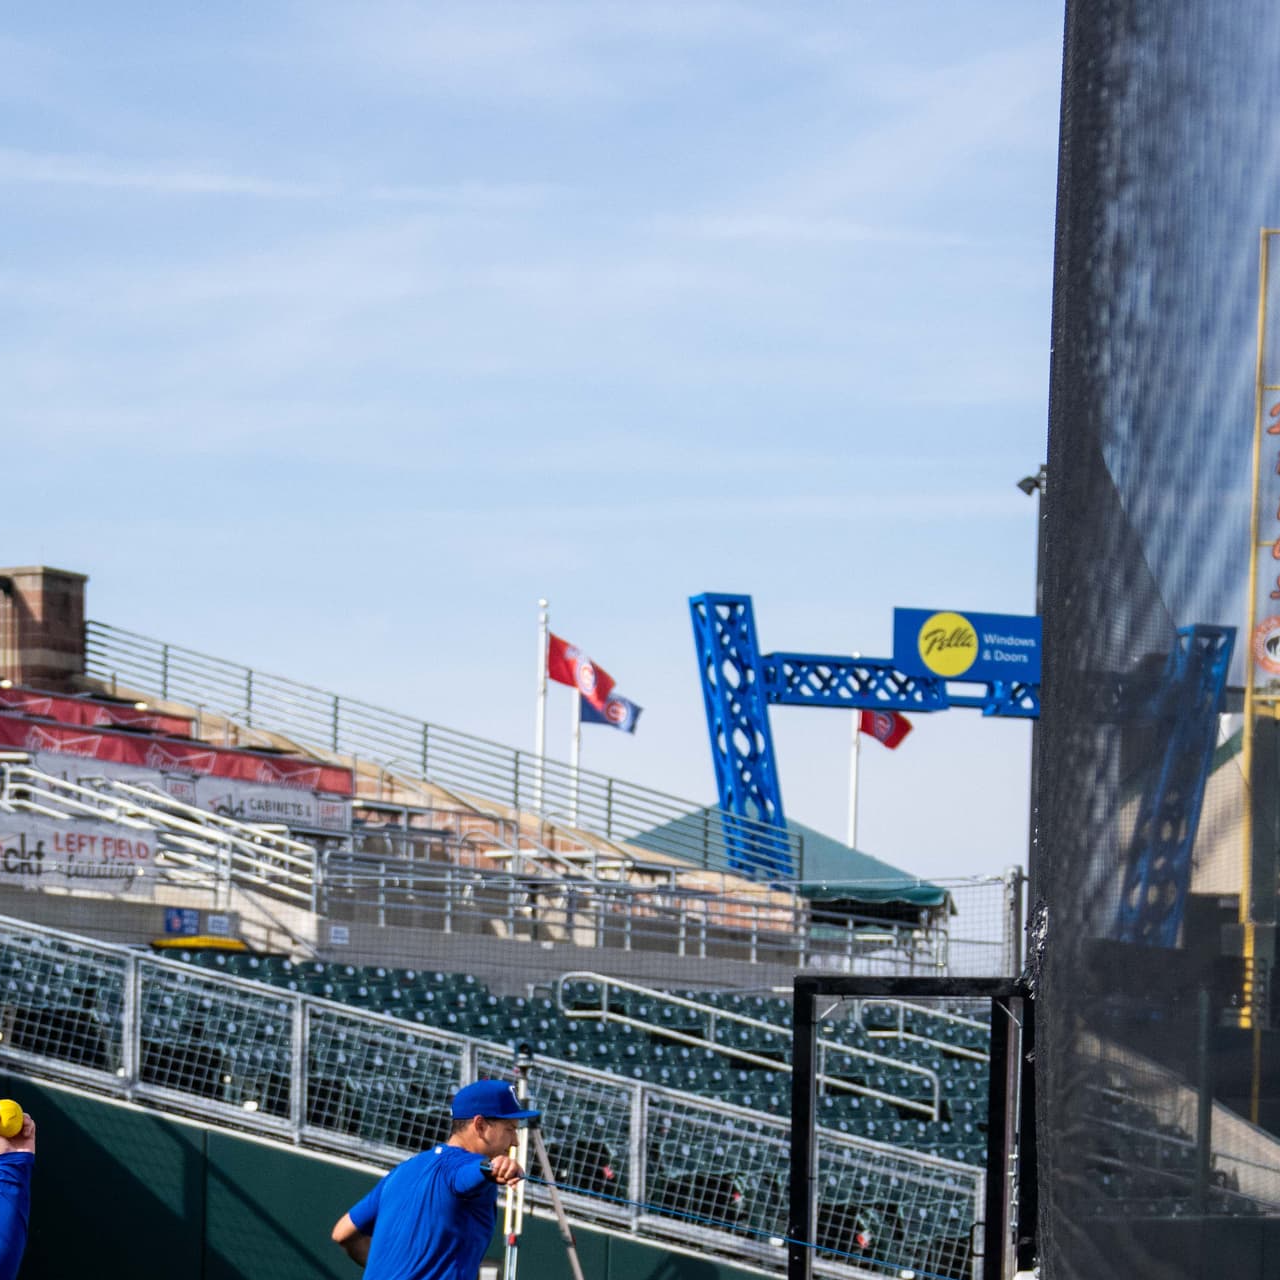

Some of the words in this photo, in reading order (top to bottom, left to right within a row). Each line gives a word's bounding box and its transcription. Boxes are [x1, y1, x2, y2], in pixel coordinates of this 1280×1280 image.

[924, 626, 974, 656] Pella
[982, 633, 1036, 647] Windows
[982, 649, 992, 661] &
[993, 650, 1029, 663] Doors
[53, 831, 98, 854] LEFT
